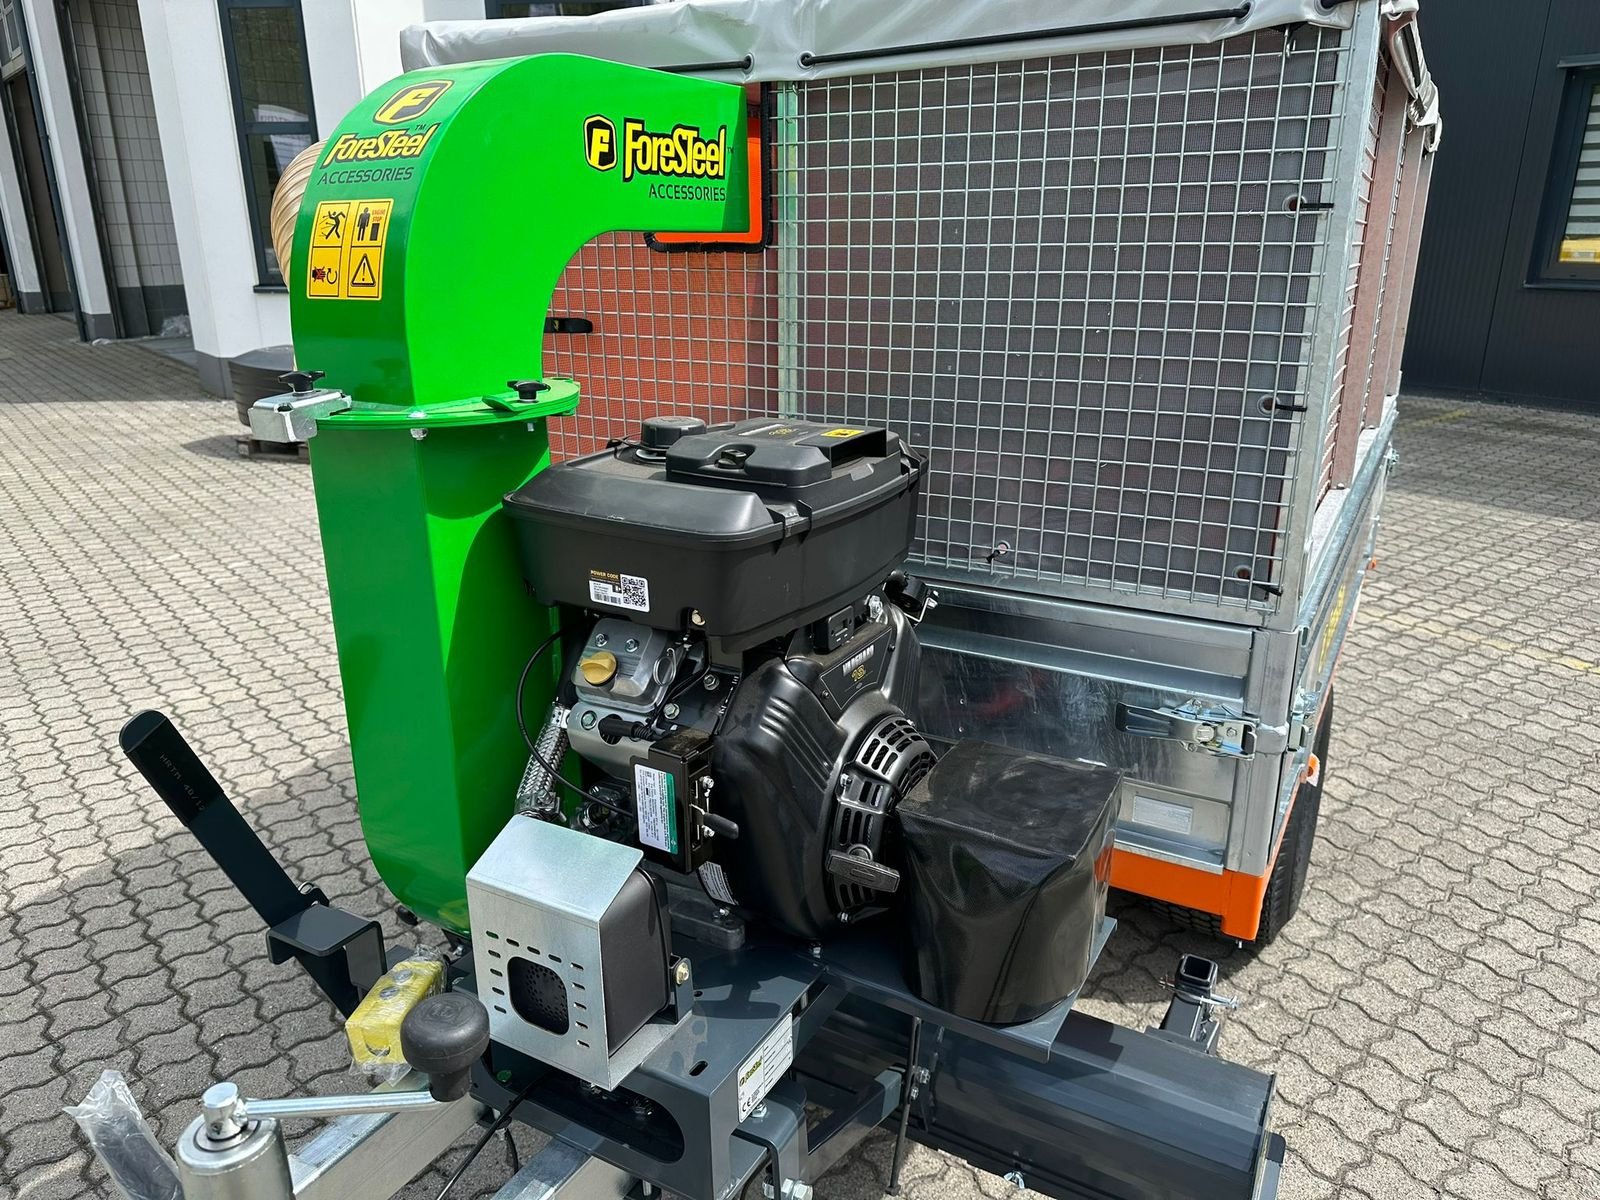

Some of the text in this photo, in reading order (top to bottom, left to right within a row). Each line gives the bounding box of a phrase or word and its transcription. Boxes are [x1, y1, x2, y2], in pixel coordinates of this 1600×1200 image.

[317, 167, 414, 185] ACCESSORIES
[649, 183, 726, 202] ACCESSORIES
[590, 569, 619, 580] POWER CODE
